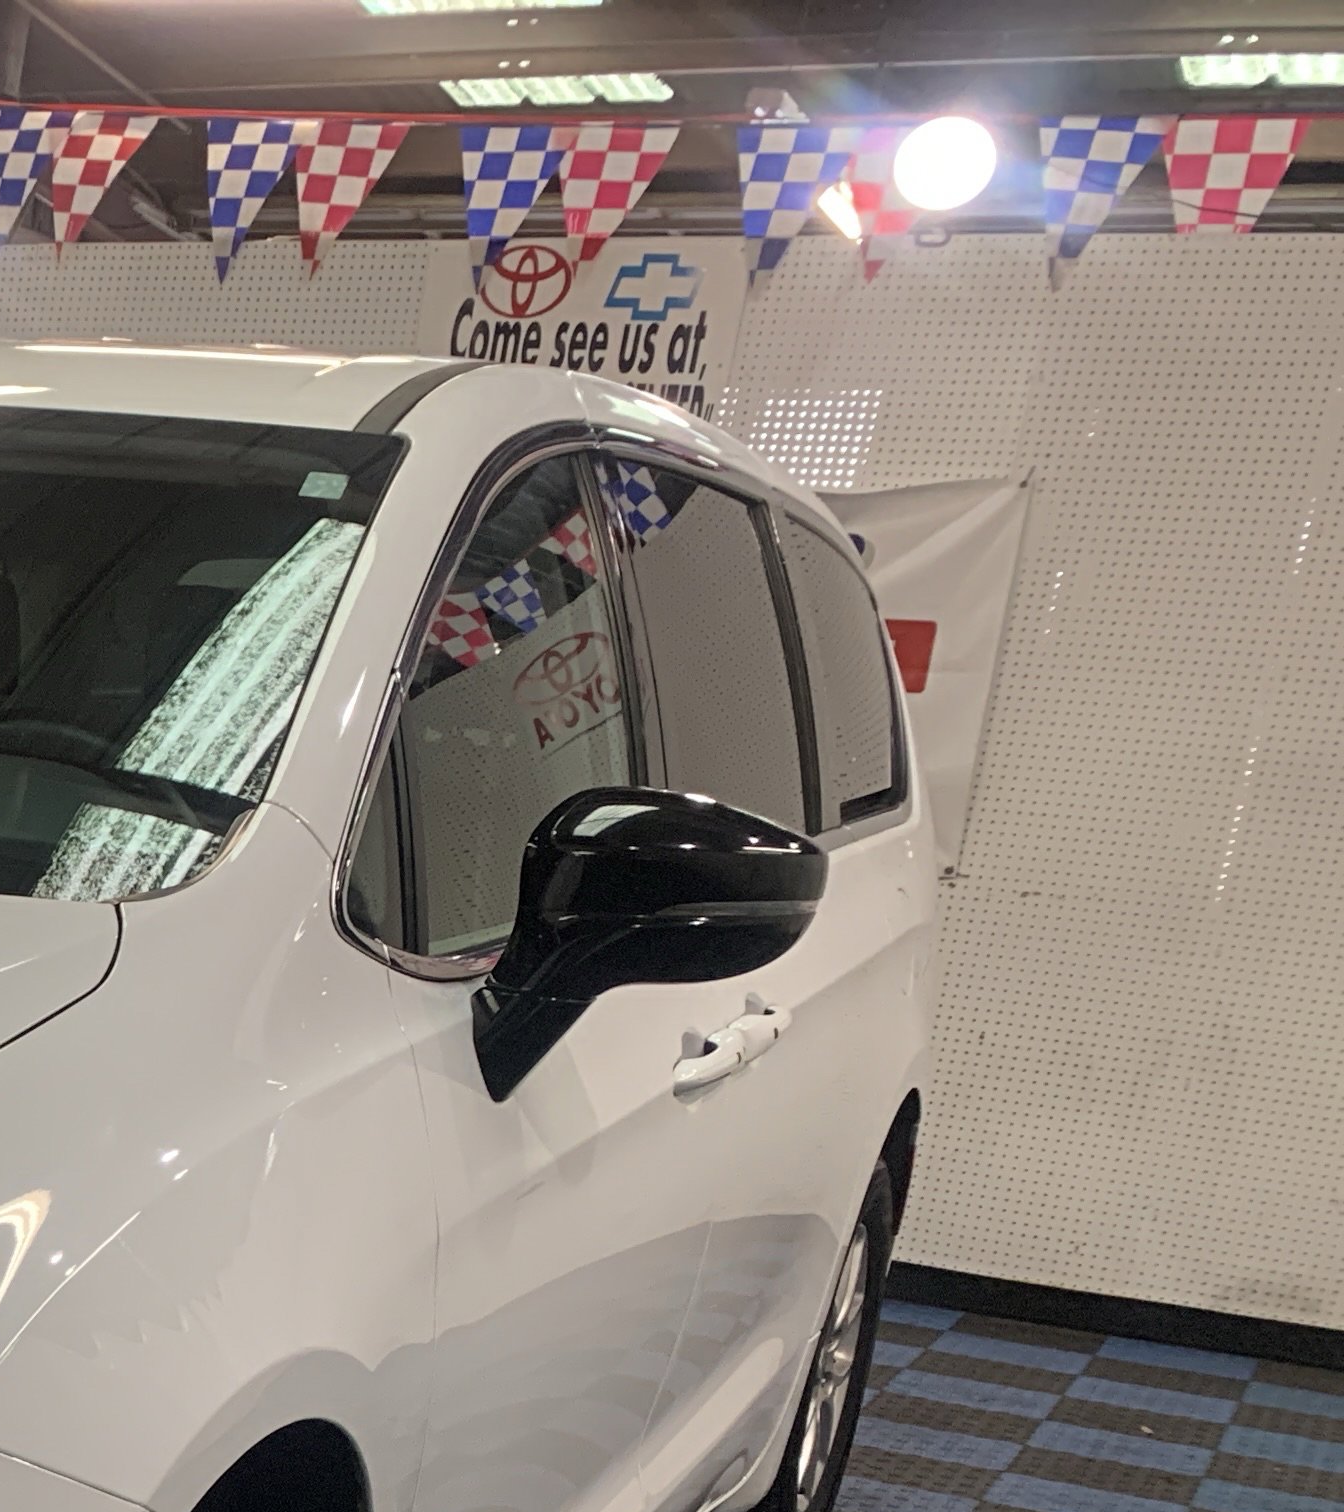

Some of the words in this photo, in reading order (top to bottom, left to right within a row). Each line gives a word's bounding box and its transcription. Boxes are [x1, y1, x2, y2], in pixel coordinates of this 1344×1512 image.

[450, 298, 541, 364] Come
[549, 321, 609, 372] see
[618, 322, 659, 374] us
[667, 310, 707, 381] at,
